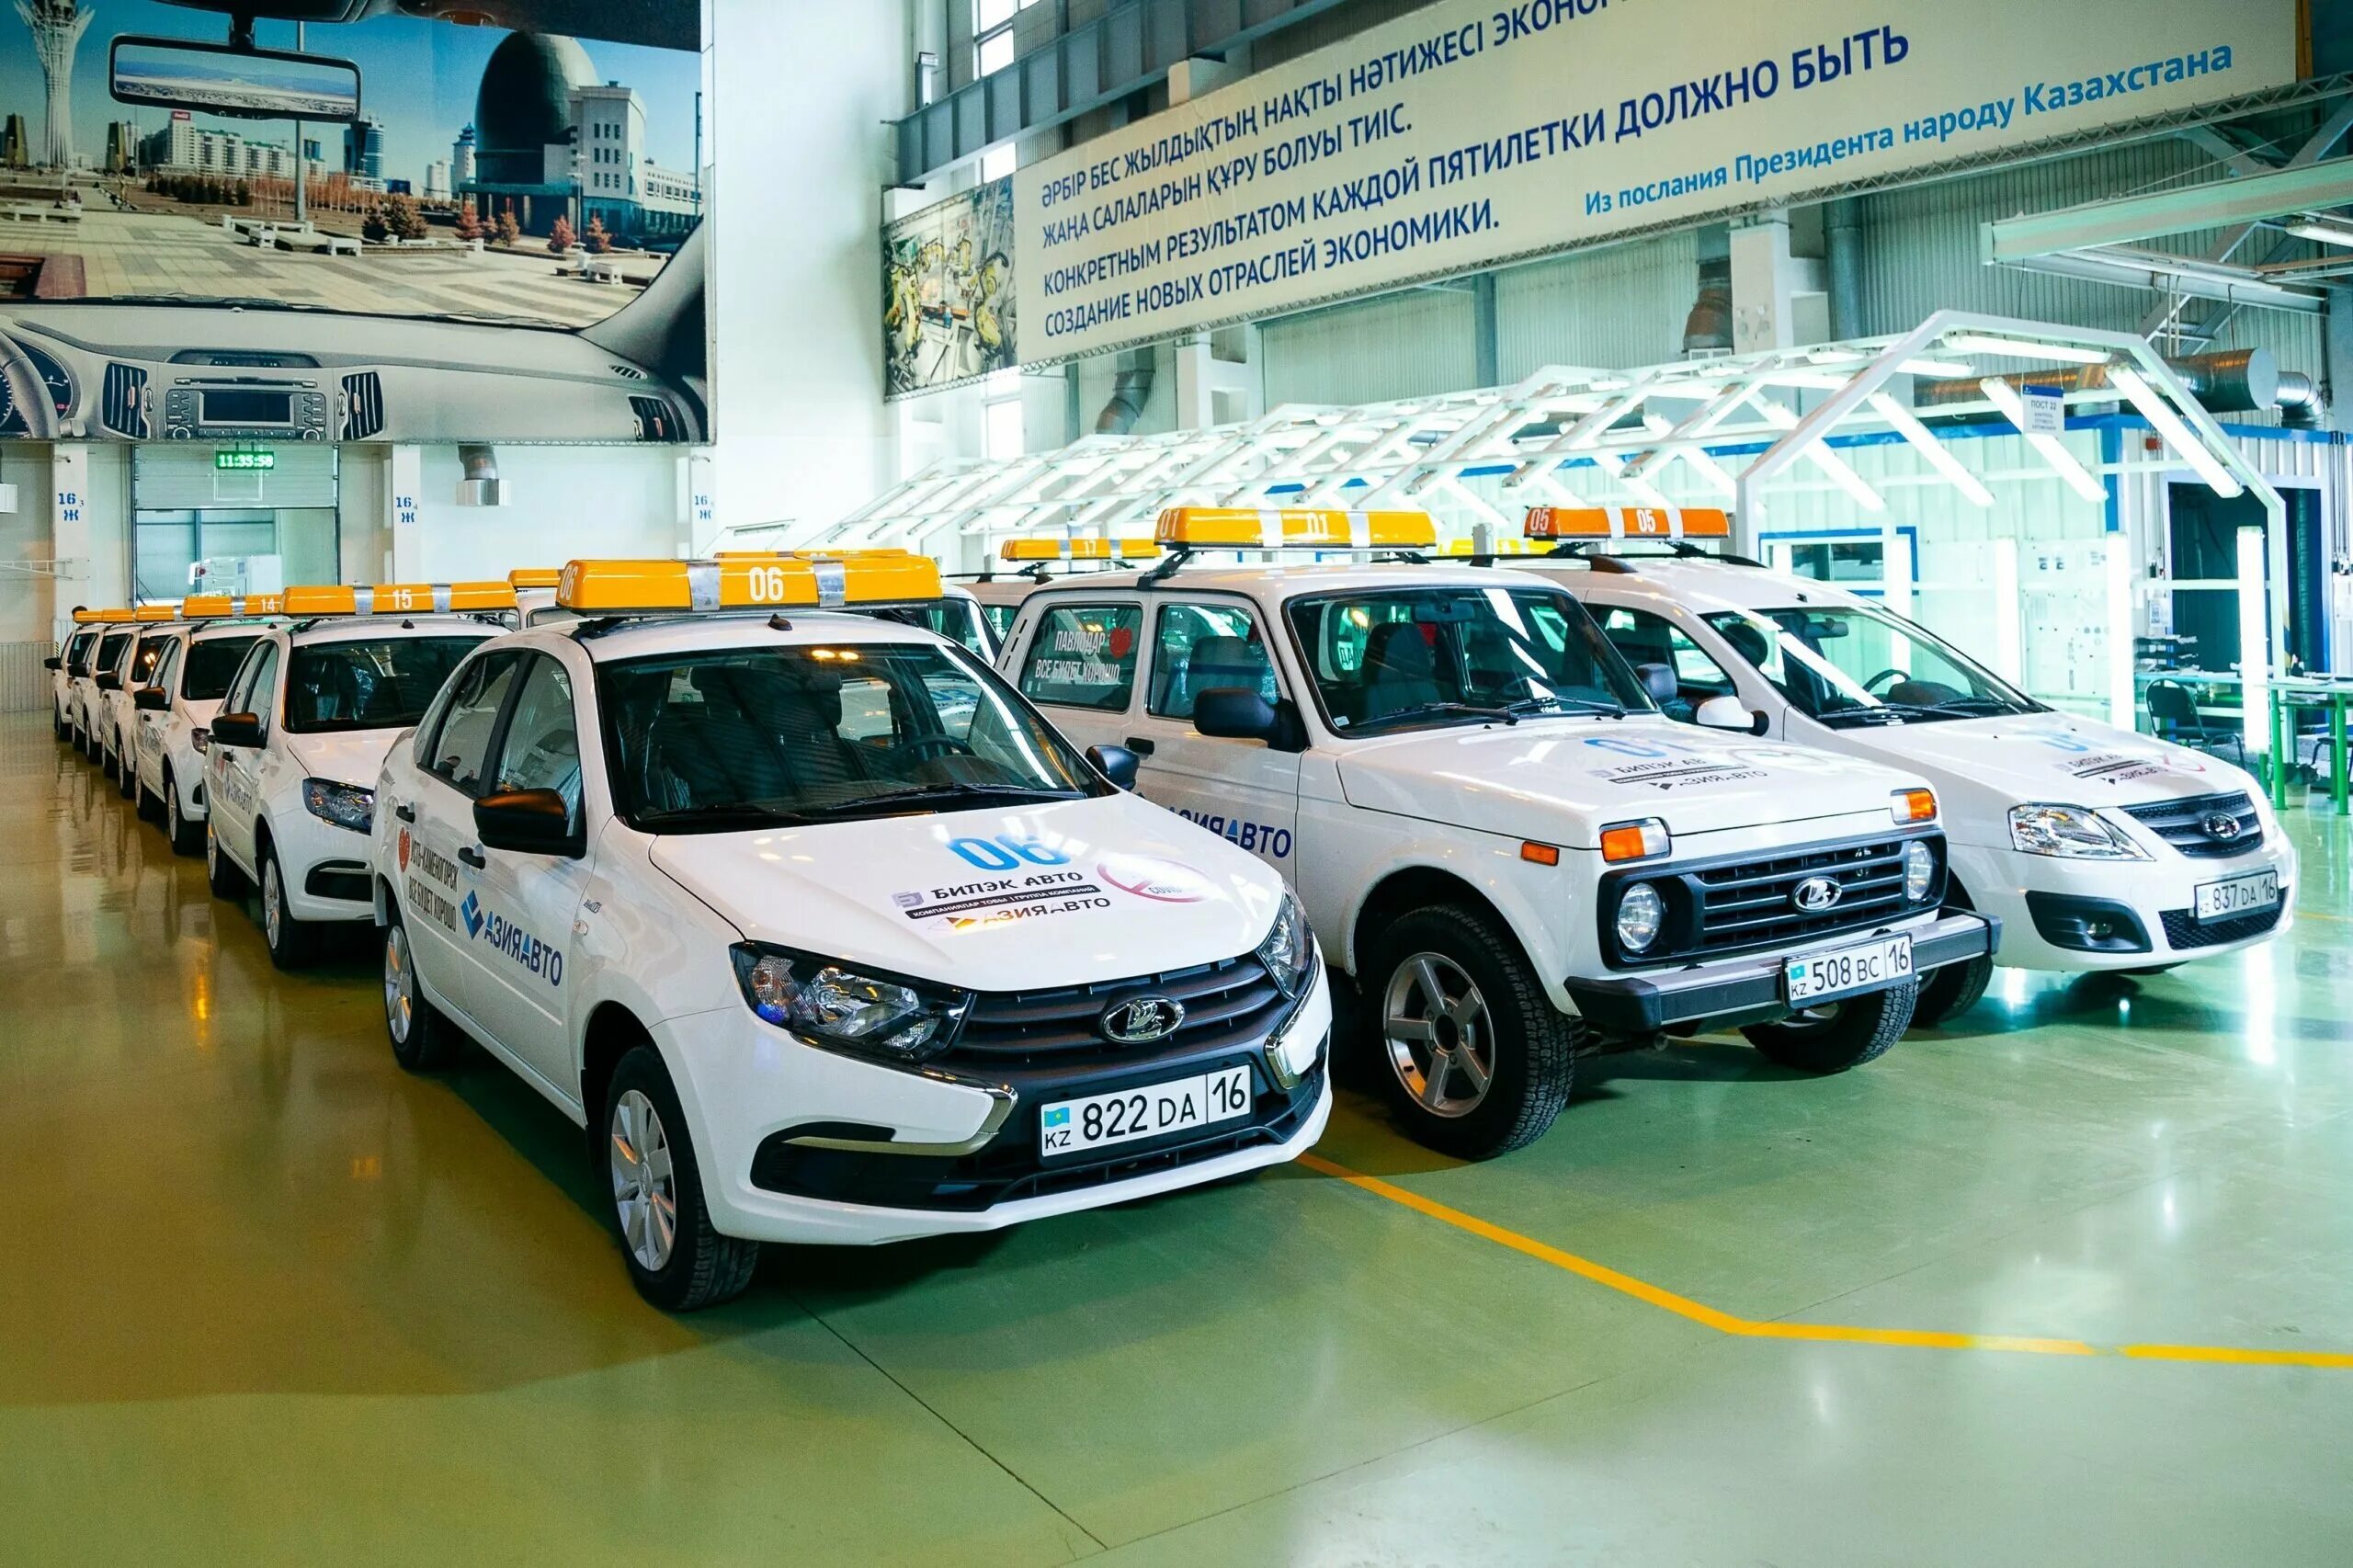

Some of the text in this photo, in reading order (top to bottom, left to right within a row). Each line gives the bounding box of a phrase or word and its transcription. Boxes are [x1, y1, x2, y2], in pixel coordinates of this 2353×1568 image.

[1041, 171, 1086, 208] ӘРБІР
[1090, 156, 1120, 190] БЕС
[1124, 106, 1258, 178] ЖЫЛДЫҚТЫҢ
[1264, 74, 1342, 128] НАҚТЫ
[1350, 21, 1483, 97] НӘТИЖЕСІ
[1586, 45, 2233, 216] Из послания Президента народу Казахстана
[1042, 103, 1412, 248] ЖАҢА САЛАЛАРЫН ҚҰРУ БОЛУЫ ТИІС.
[1043, 25, 1909, 297] КОНКРЕТНЫМ РЕЗУЛЬТАТОМ КАЖДОЙ ПЯТИЛЕТКИ ДОЛЖНО БЫТЬ
[1045, 199, 1500, 336] СОЗДАНИЕ НОВЫХ ОТРАСЛЕЙ ЭКОНОМИКИ.
[2030, 400, 2048, 410] ПОСТ
[58, 493, 76, 505] 16
[396, 496, 412, 508] 16
[695, 495, 708, 506] 16
[63, 509, 79, 521] Ж
[401, 512, 415, 523] Ж
[1159, 508, 1180, 538] 01
[1529, 508, 1551, 531] 05
[1636, 508, 1656, 533] 05
[560, 563, 579, 601] 06
[749, 566, 784, 602] 06
[260, 597, 276, 612] 14
[392, 588, 413, 610] 15
[1169, 807, 1291, 858] ИЯАВТО
[946, 833, 1072, 870] 06
[930, 872, 1084, 900] БИПЭК АВТО
[2213, 876, 2276, 911] 837 DA 16
[483, 911, 563, 986] АЗИЯАВТО
[1813, 941, 1909, 992] 508 BC 16
[1791, 983, 1808, 996] KZ
[1083, 1073, 1245, 1142] 822 DA 16
[1044, 1130, 1071, 1149] KZ
